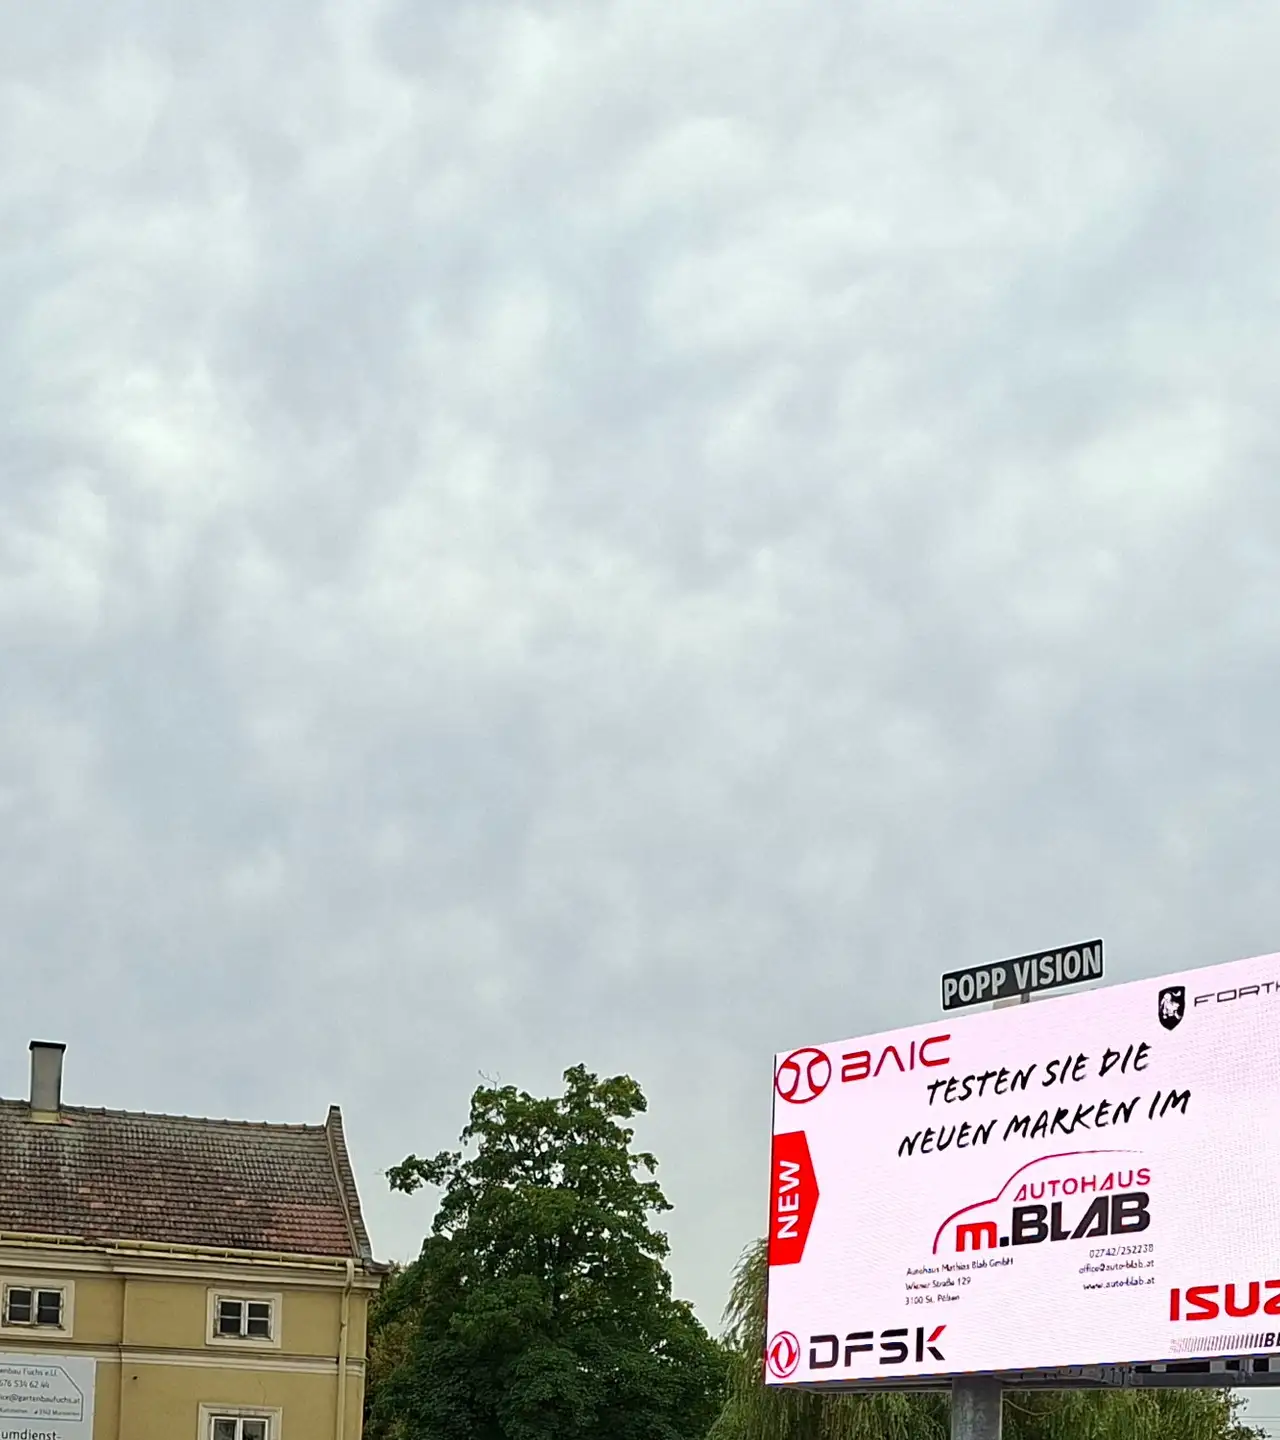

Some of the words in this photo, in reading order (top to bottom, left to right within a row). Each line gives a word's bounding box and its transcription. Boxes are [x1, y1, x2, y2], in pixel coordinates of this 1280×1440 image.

[943, 966, 1007, 1006] POPP
[1013, 945, 1101, 990] VISION
[841, 1034, 951, 1083] BAIC
[927, 1065, 1035, 1105] TESTEN
[1042, 1053, 1087, 1087] SIE
[1098, 1042, 1152, 1077] DIE
[898, 1119, 998, 1158] NEUEN
[1003, 1096, 1140, 1142] MARKEN
[1148, 1089, 1191, 1118] IM
[776, 1160, 801, 1239] NEW
[1014, 1168, 1151, 1202] AUTOHAUS
[955, 1192, 1152, 1252] m.BLAB
[957, 1276, 972, 1286] 129
[809, 1324, 947, 1370] DFSK
